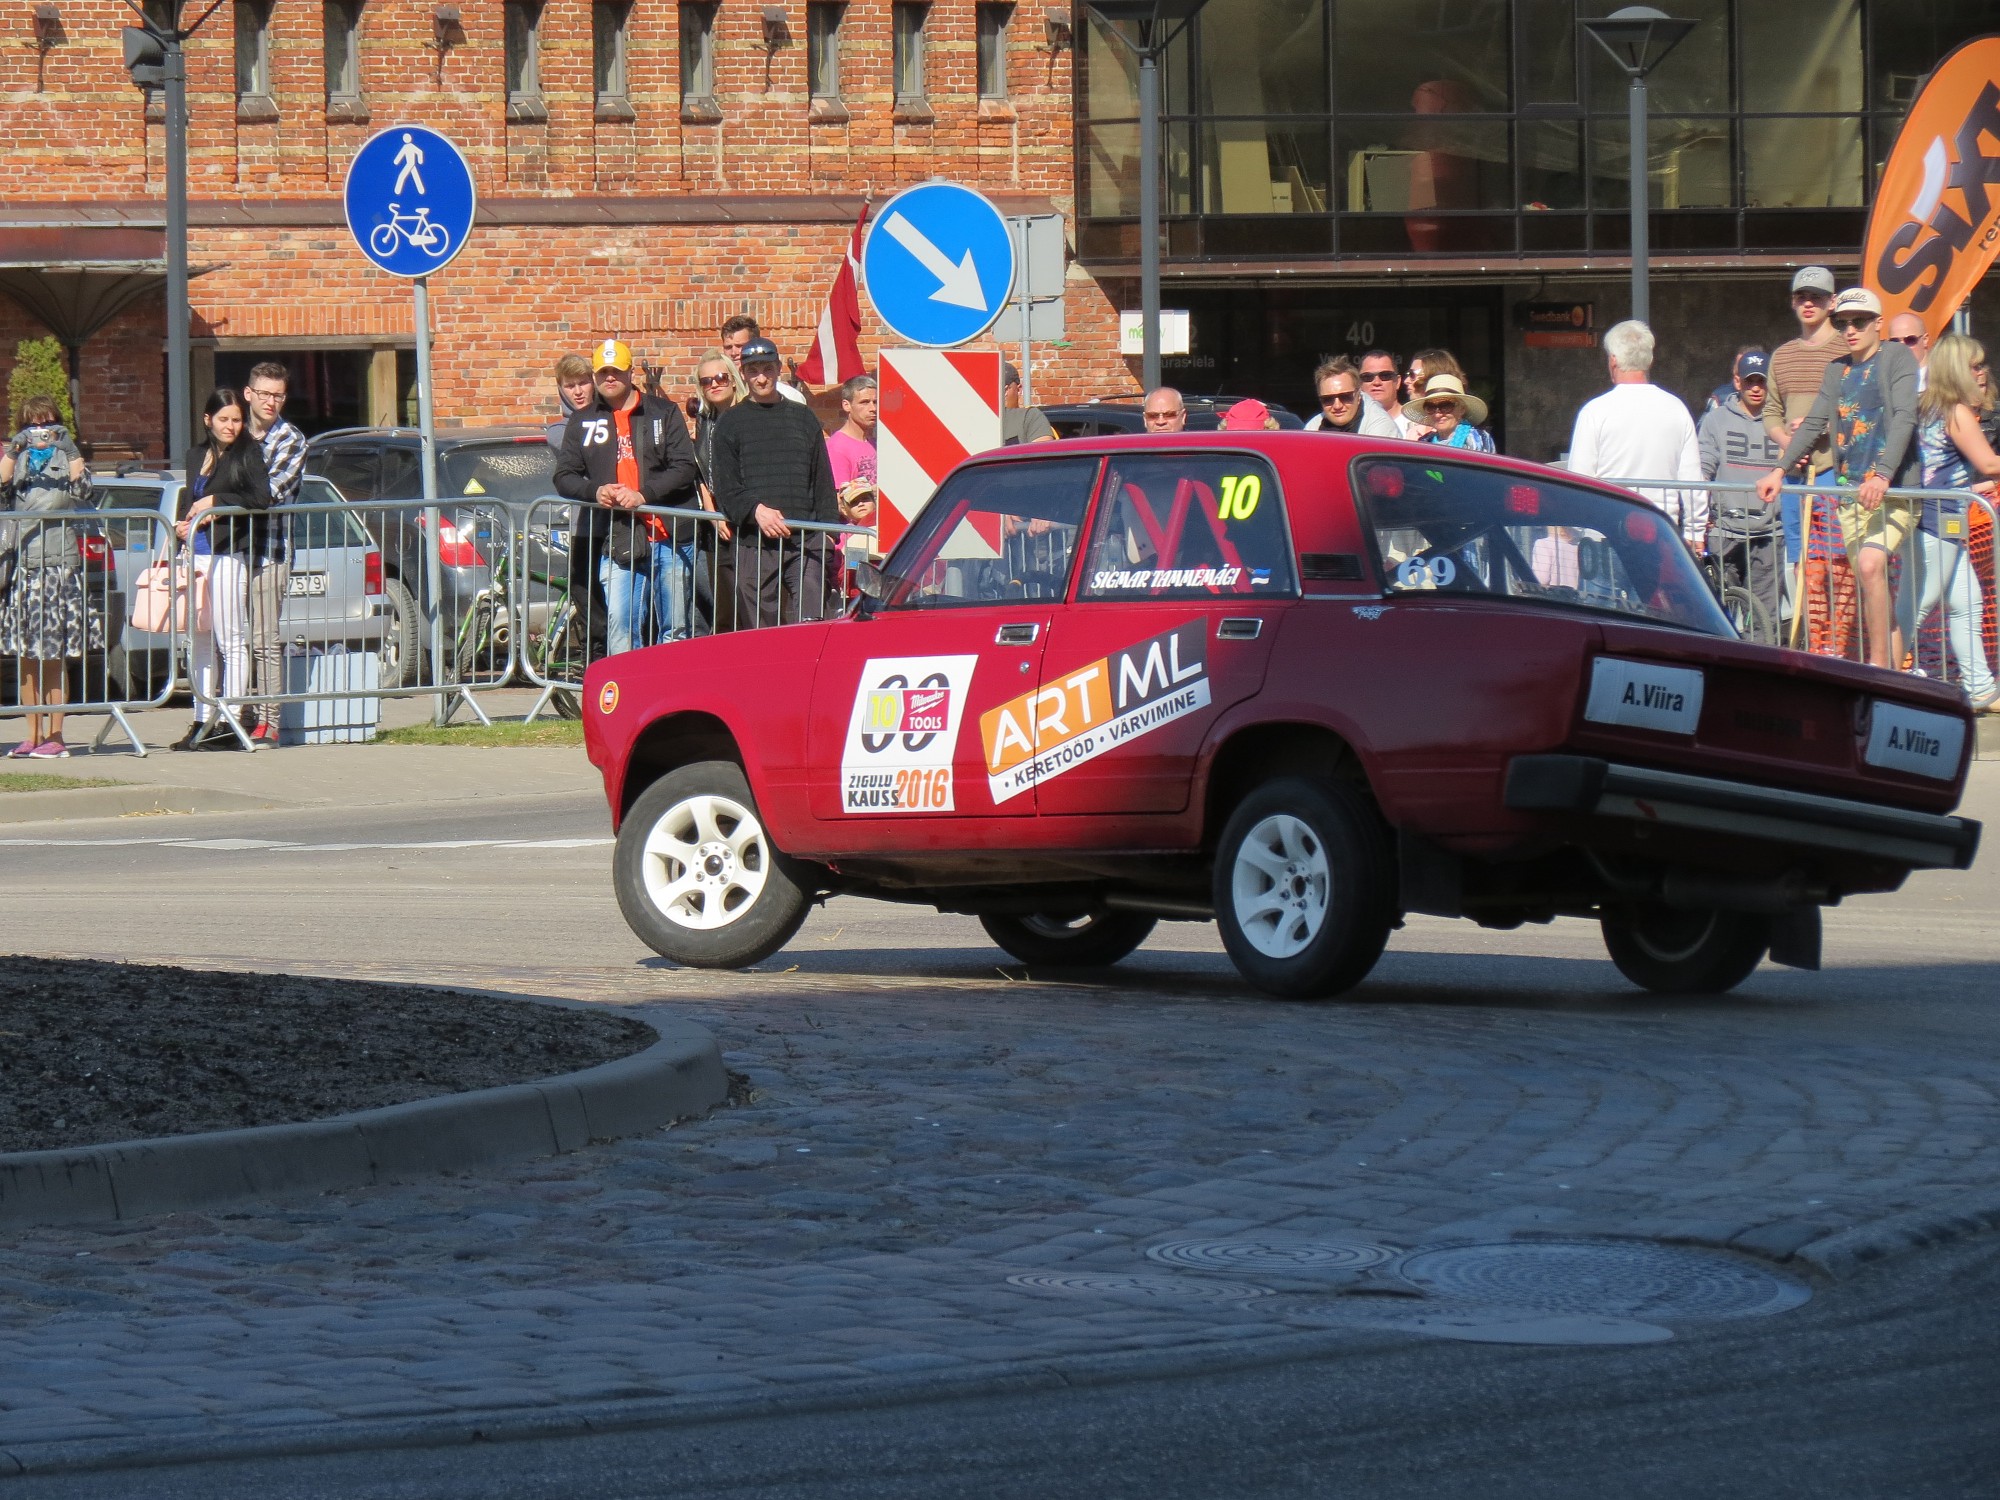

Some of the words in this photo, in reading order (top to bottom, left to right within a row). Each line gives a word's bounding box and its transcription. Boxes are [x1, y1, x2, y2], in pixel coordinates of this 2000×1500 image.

[1346, 321, 1375, 346] 40
[582, 419, 609, 447] 75
[1218, 475, 1261, 520] 10
[1091, 570, 1151, 589] SIGMAR
[1397, 556, 1456, 588] 69
[871, 694, 897, 728] 10
[991, 667, 1099, 769] ART
[1118, 633, 1203, 709] ML
[1622, 681, 1685, 712] A.Viira
[909, 716, 942, 730] TOOLS
[1014, 738, 1095, 788] KERETÖÖD
[1109, 690, 1197, 742] VÄRVIMINE
[1887, 726, 1941, 757] A.Viira
[848, 790, 899, 807] KAUSS
[894, 769, 950, 809] 2016
